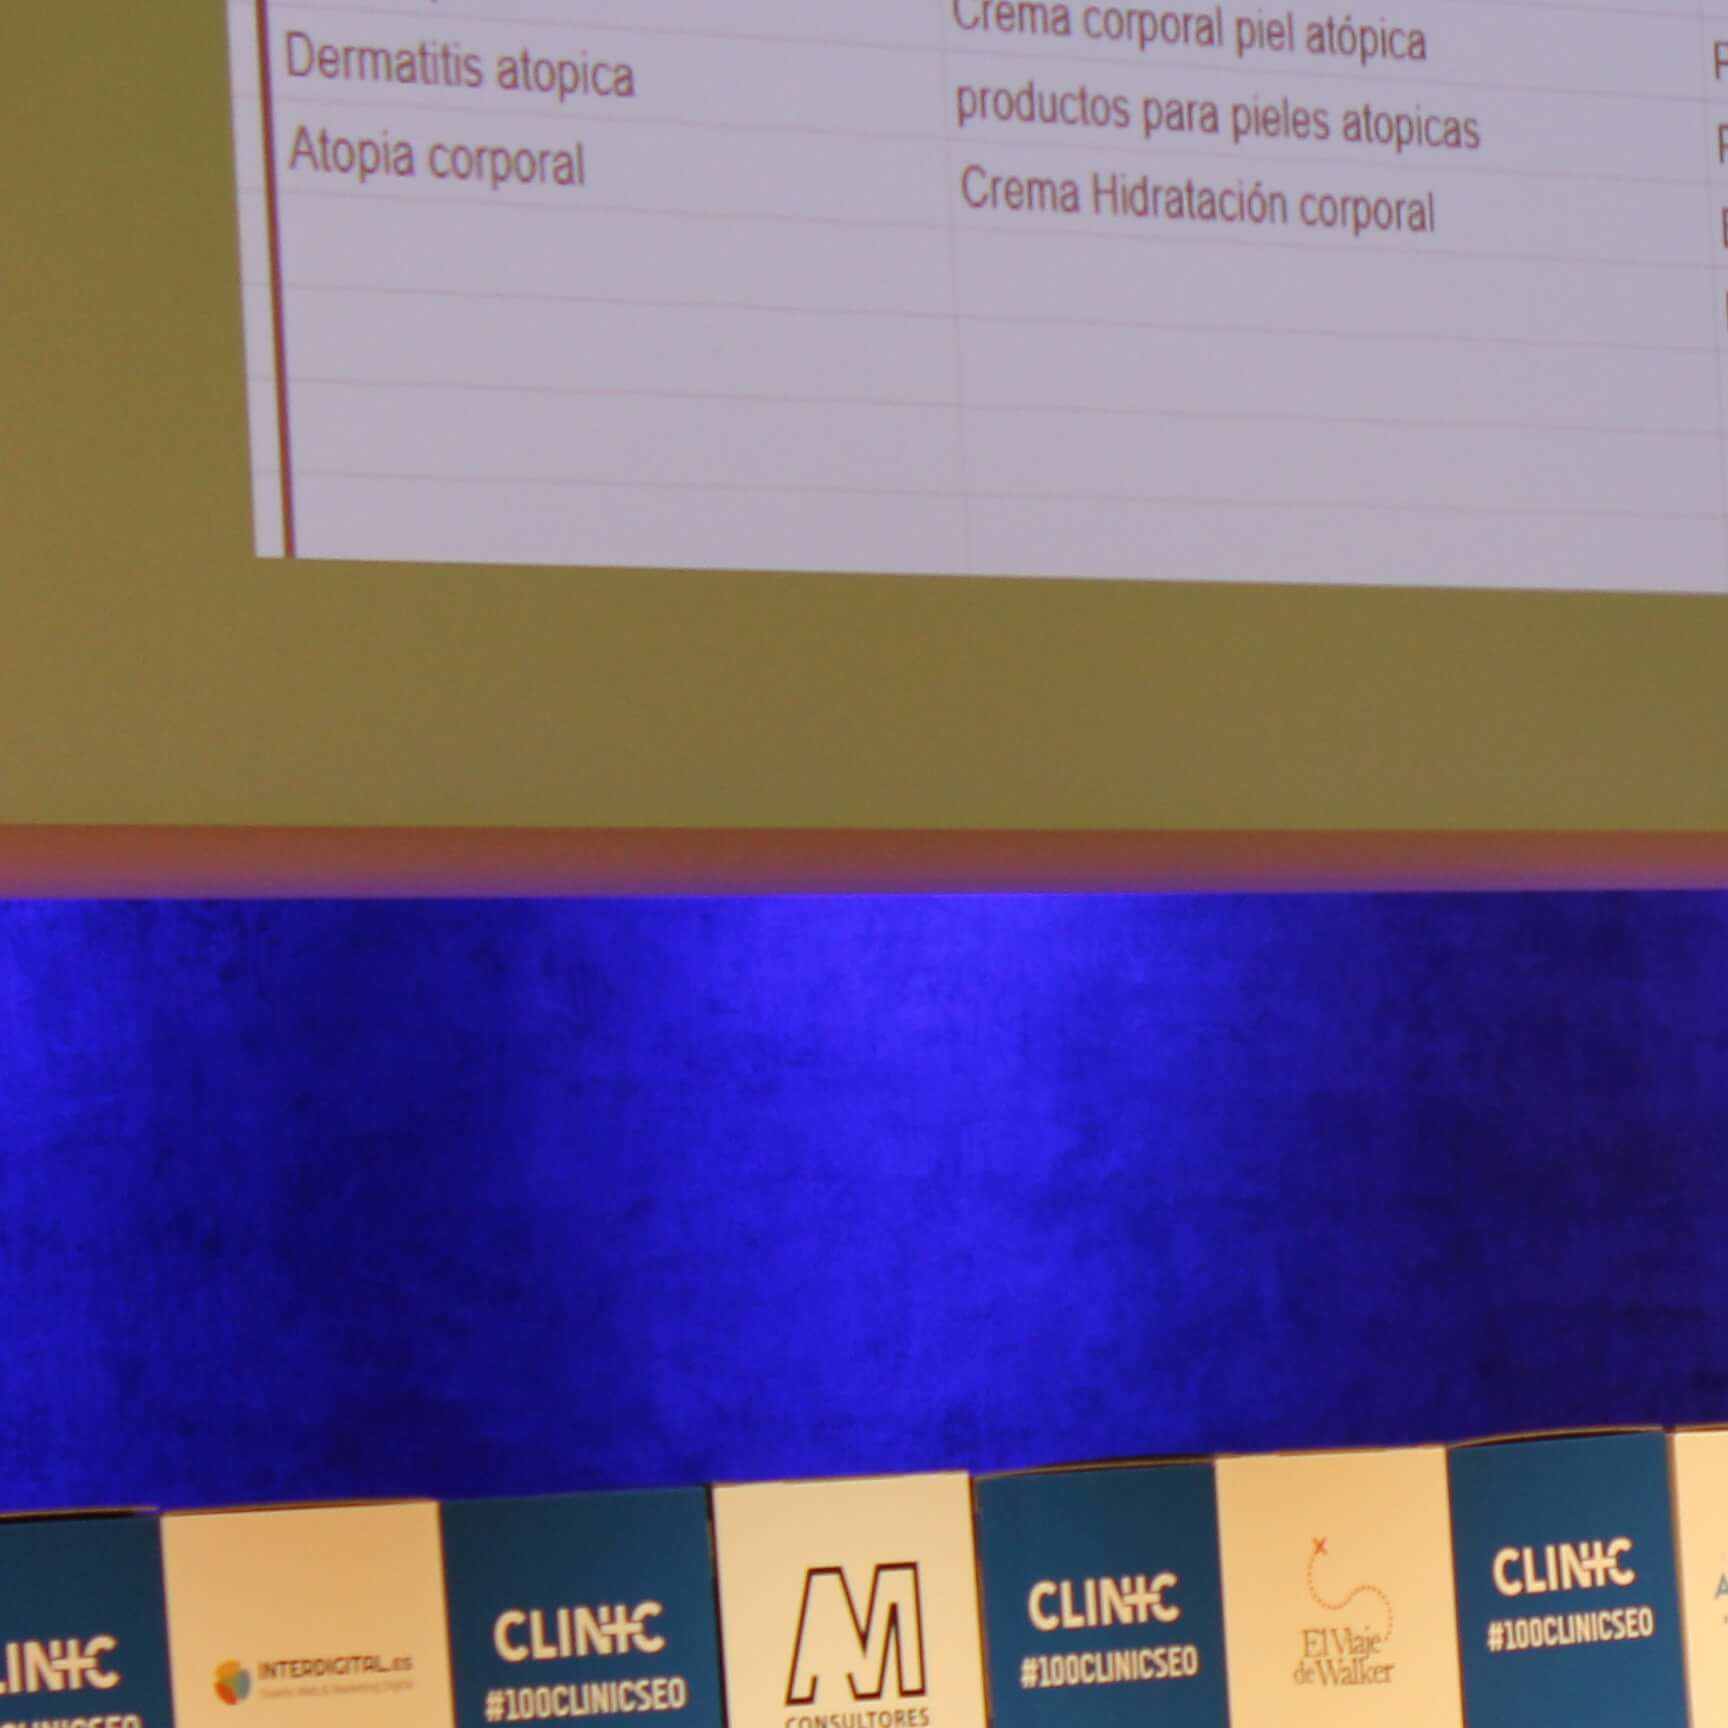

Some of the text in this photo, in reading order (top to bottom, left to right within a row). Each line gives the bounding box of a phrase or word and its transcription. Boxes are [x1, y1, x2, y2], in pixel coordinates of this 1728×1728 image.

[954, 0, 1427, 67] Crema corporal piel atópica
[285, 31, 636, 103] Dermatitis atopica
[956, 79, 1480, 153] productos para pieles atopicas
[289, 125, 585, 191] Atopia corporal
[962, 165, 1435, 238] Crema Hidratación corporal
[1301, 1627, 1327, 1658] El
[1488, 1606, 1654, 1652] #100CLINICSEO
[1021, 1645, 1198, 1691] #100CLINICSEO
[1292, 1657, 1395, 1688] de Walker
[485, 1678, 686, 1725] #100CLINICSEO
